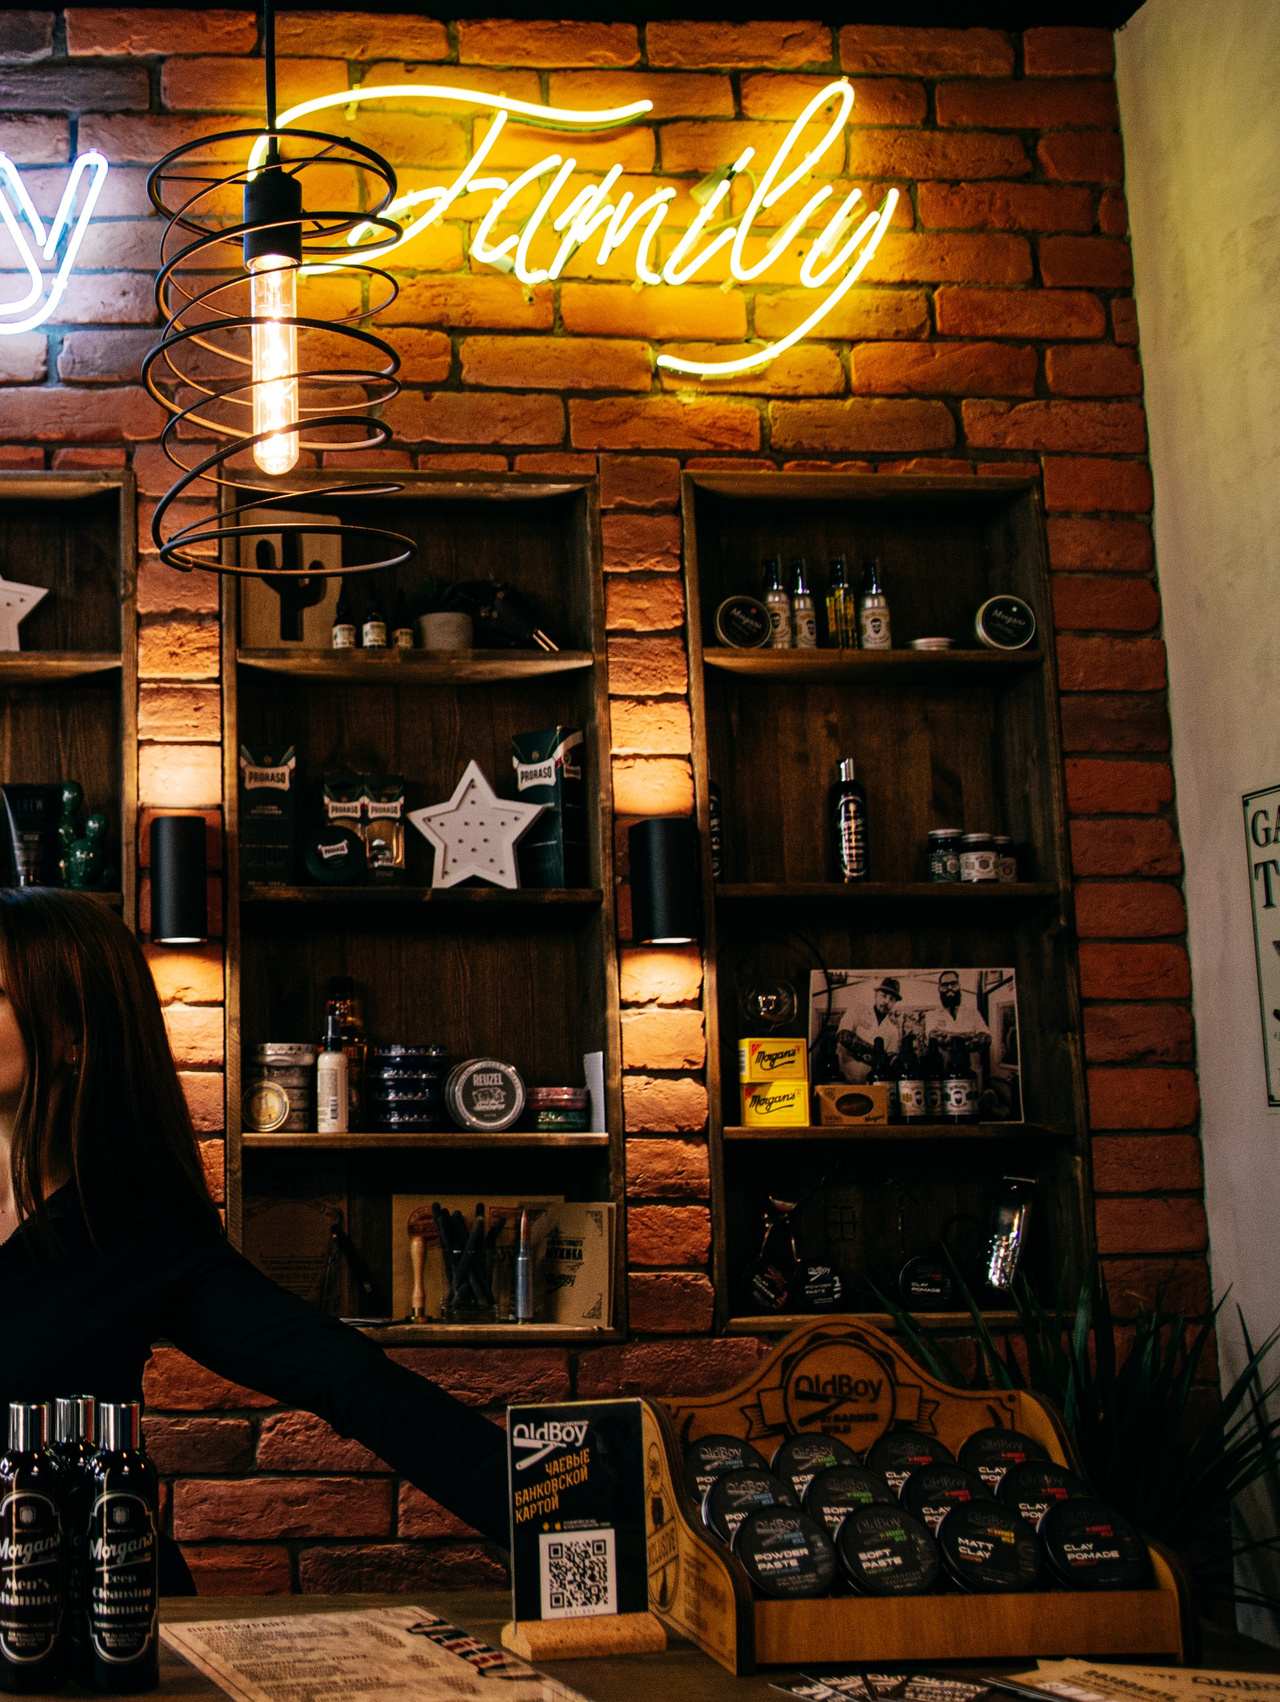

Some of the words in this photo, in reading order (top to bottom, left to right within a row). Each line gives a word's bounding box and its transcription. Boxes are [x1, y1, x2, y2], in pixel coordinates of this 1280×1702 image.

[246, 78, 900, 375] Family
[249, 771, 286, 784] PRORASO
[519, 766, 552, 783] PRORASO
[331, 804, 359, 814] PRORASO
[371, 804, 398, 814] PRORASO
[755, 1048, 798, 1070] Morgan's
[472, 1073, 504, 1087] REUZEL
[749, 1092, 796, 1113] Morgan's
[795, 1374, 883, 1403] OldBoy
[513, 1421, 588, 1447] OldBoy
[545, 1448, 590, 1477] ЧАЕВЫЕ
[978, 1466, 1007, 1475] CLAY
[791, 1474, 816, 1483] SOF
[514, 1466, 589, 1507] БАНКОВСКОЙ
[515, 1494, 560, 1524] КАРТОЙ
[1019, 1503, 1049, 1512] CLAY
[89, 1532, 153, 1564] Morgan's
[957, 1537, 995, 1551] MATT
[1064, 1543, 1094, 1552] CLAY
[754, 1548, 810, 1561] POWDER
[858, 1548, 891, 1561] SOFT
[958, 1546, 993, 1560] CLAY
[1067, 1550, 1120, 1562] POMADE
[757, 1559, 800, 1571] PASTE
[862, 1556, 904, 1570] PASTE
[5, 1577, 50, 1591] Men's
